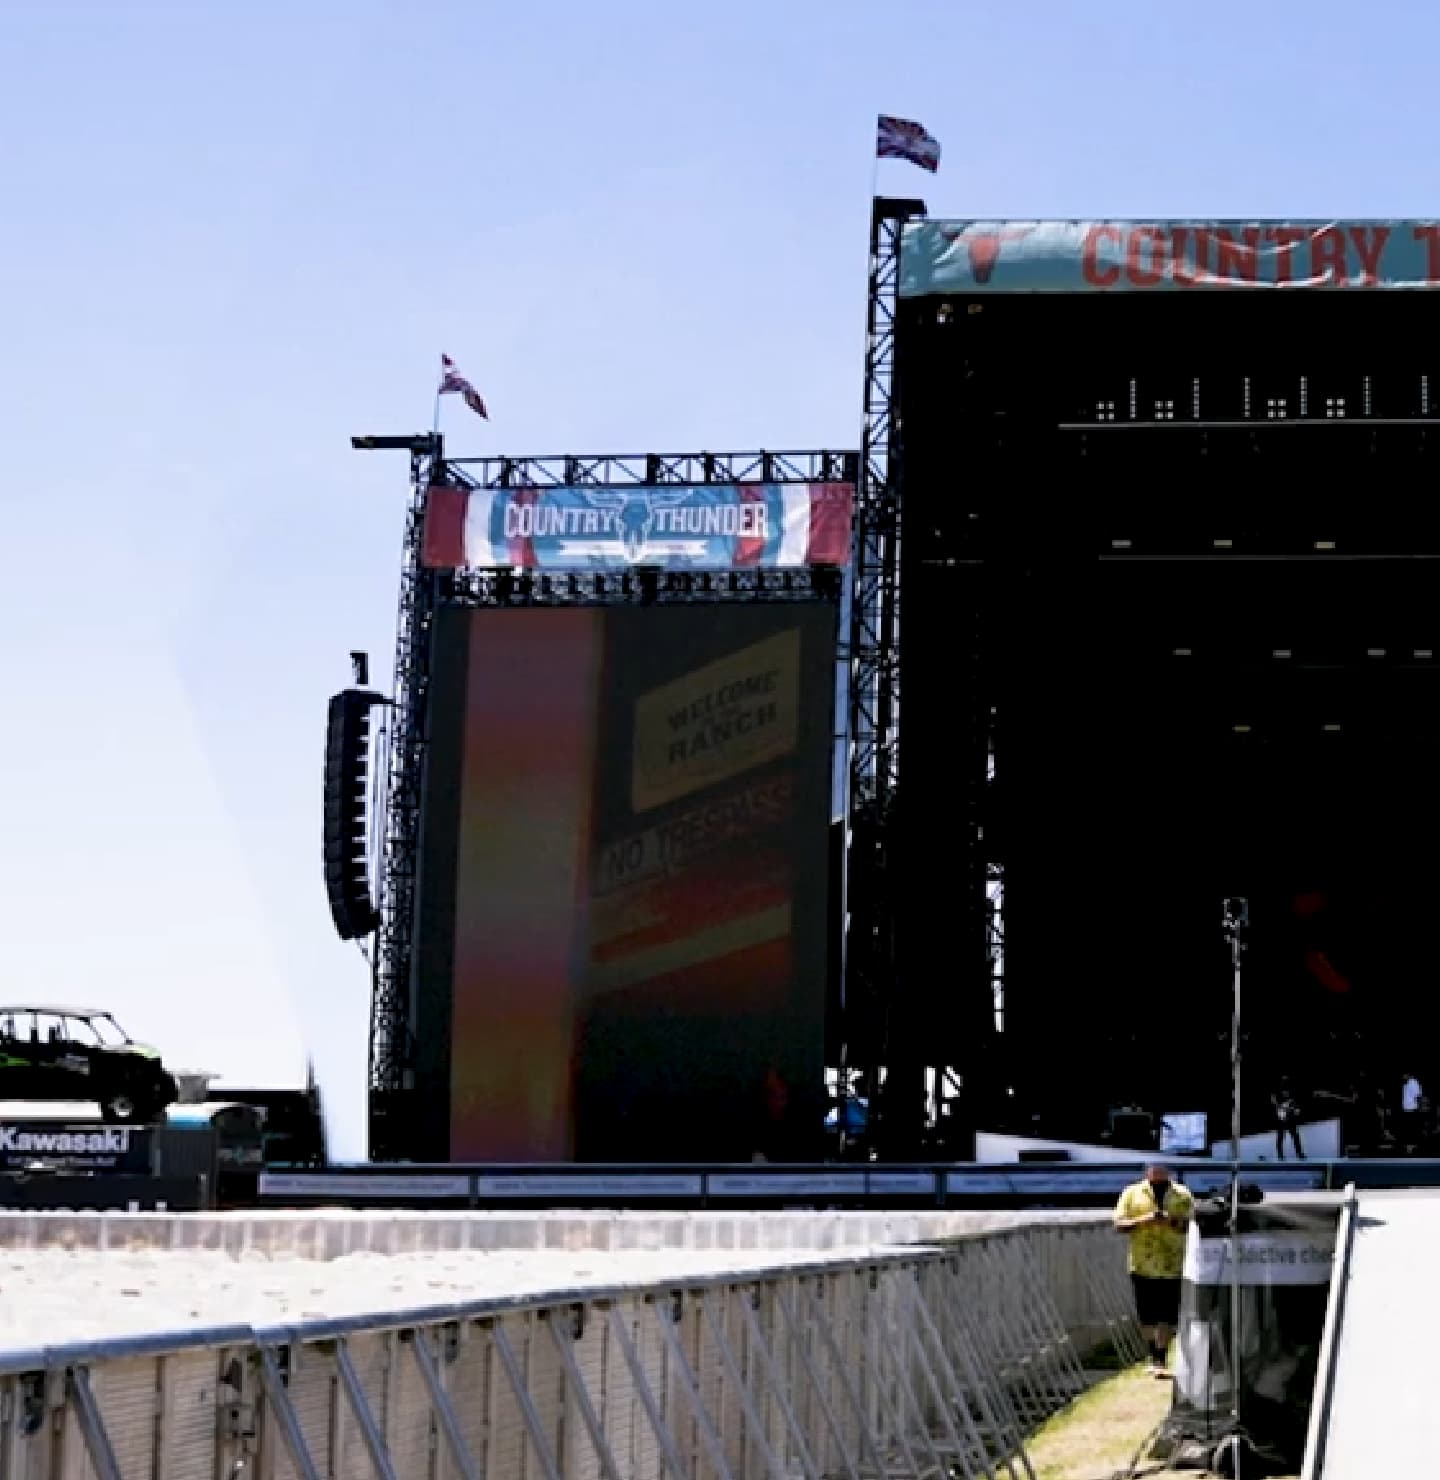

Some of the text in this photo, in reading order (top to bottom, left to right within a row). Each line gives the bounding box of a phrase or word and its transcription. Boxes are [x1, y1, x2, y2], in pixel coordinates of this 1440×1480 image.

[1082, 225, 1391, 287] COUNTRY
[504, 503, 768, 538] COUNTRY THUNDER
[668, 669, 779, 731] WELCOME
[669, 702, 777, 763] RANCH
[608, 837, 644, 877] NO
[0, 1126, 129, 1153] Kawasaki
